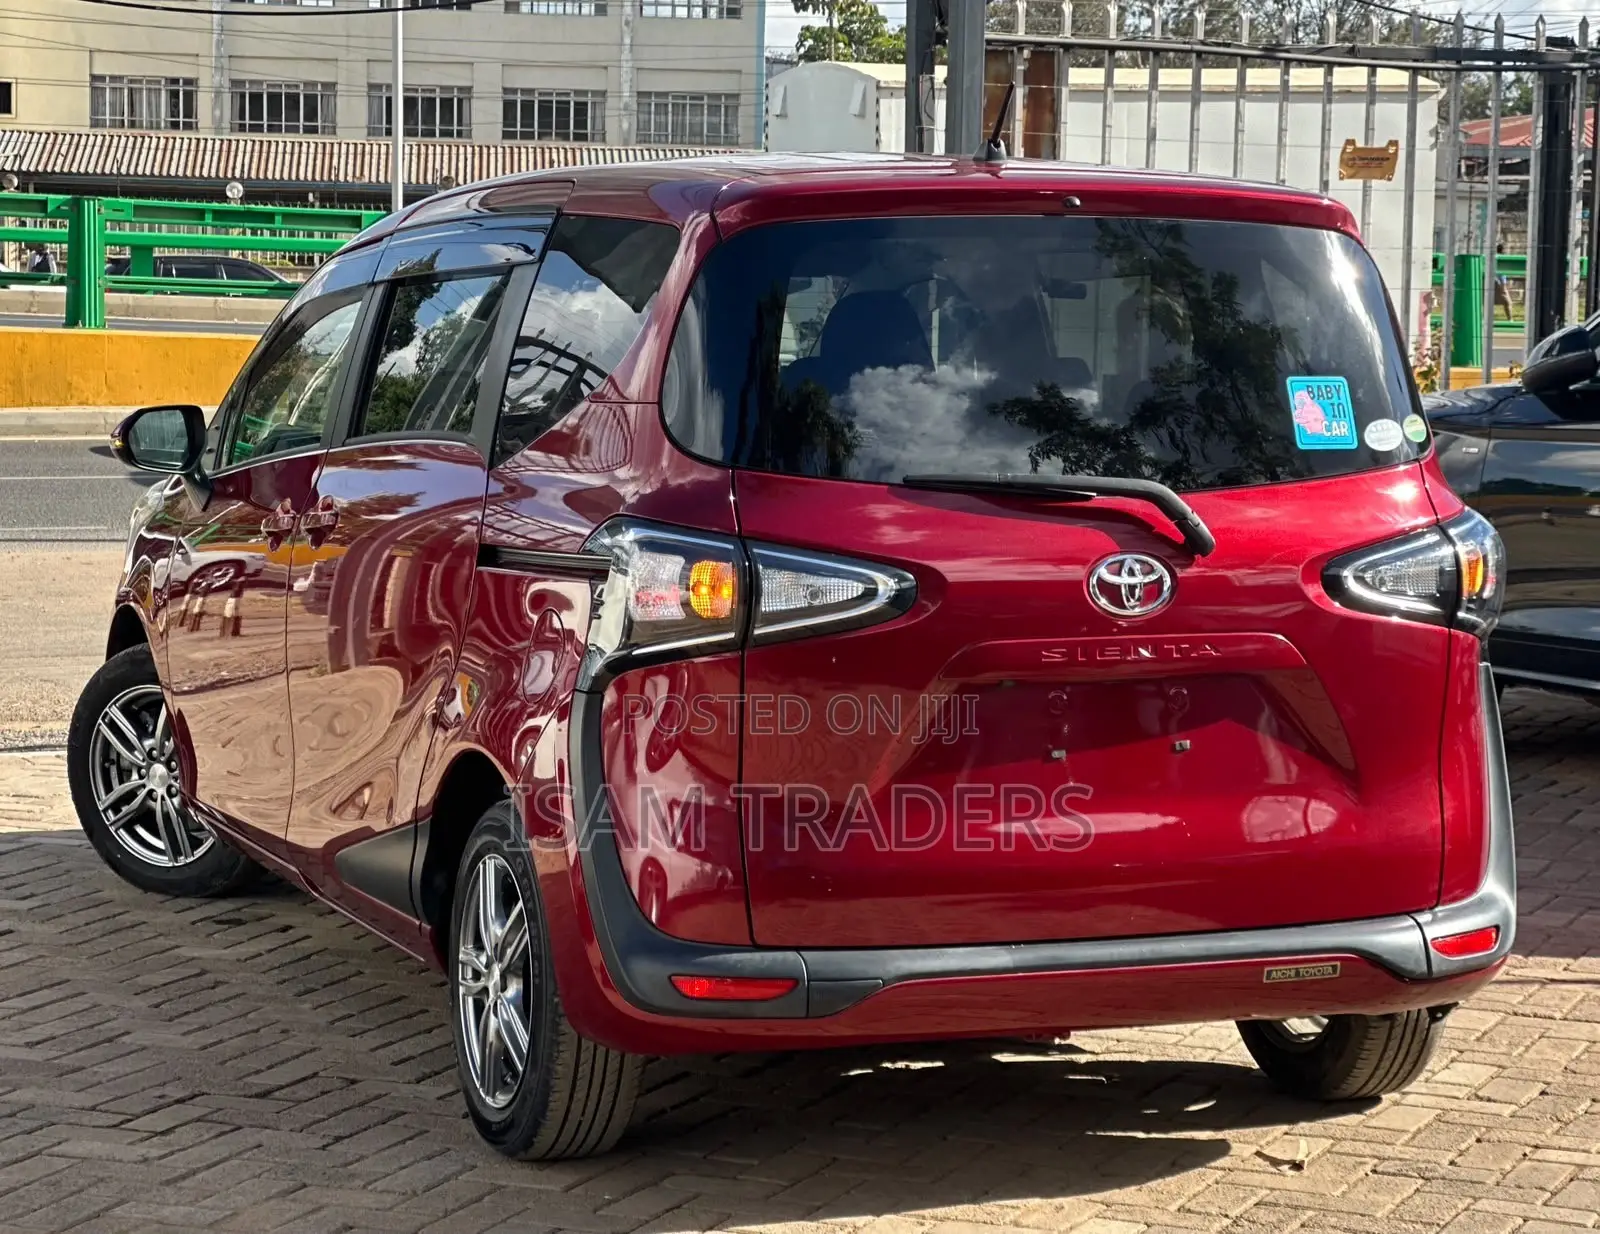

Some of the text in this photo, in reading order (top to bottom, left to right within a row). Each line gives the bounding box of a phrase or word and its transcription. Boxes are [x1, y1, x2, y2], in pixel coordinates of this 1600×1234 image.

[1306, 384, 1342, 400] BABY
[1322, 421, 1349, 436] CAR
[1041, 644, 1222, 662] SIENTA
[1270, 966, 1333, 979] AICHI TOYOTA
